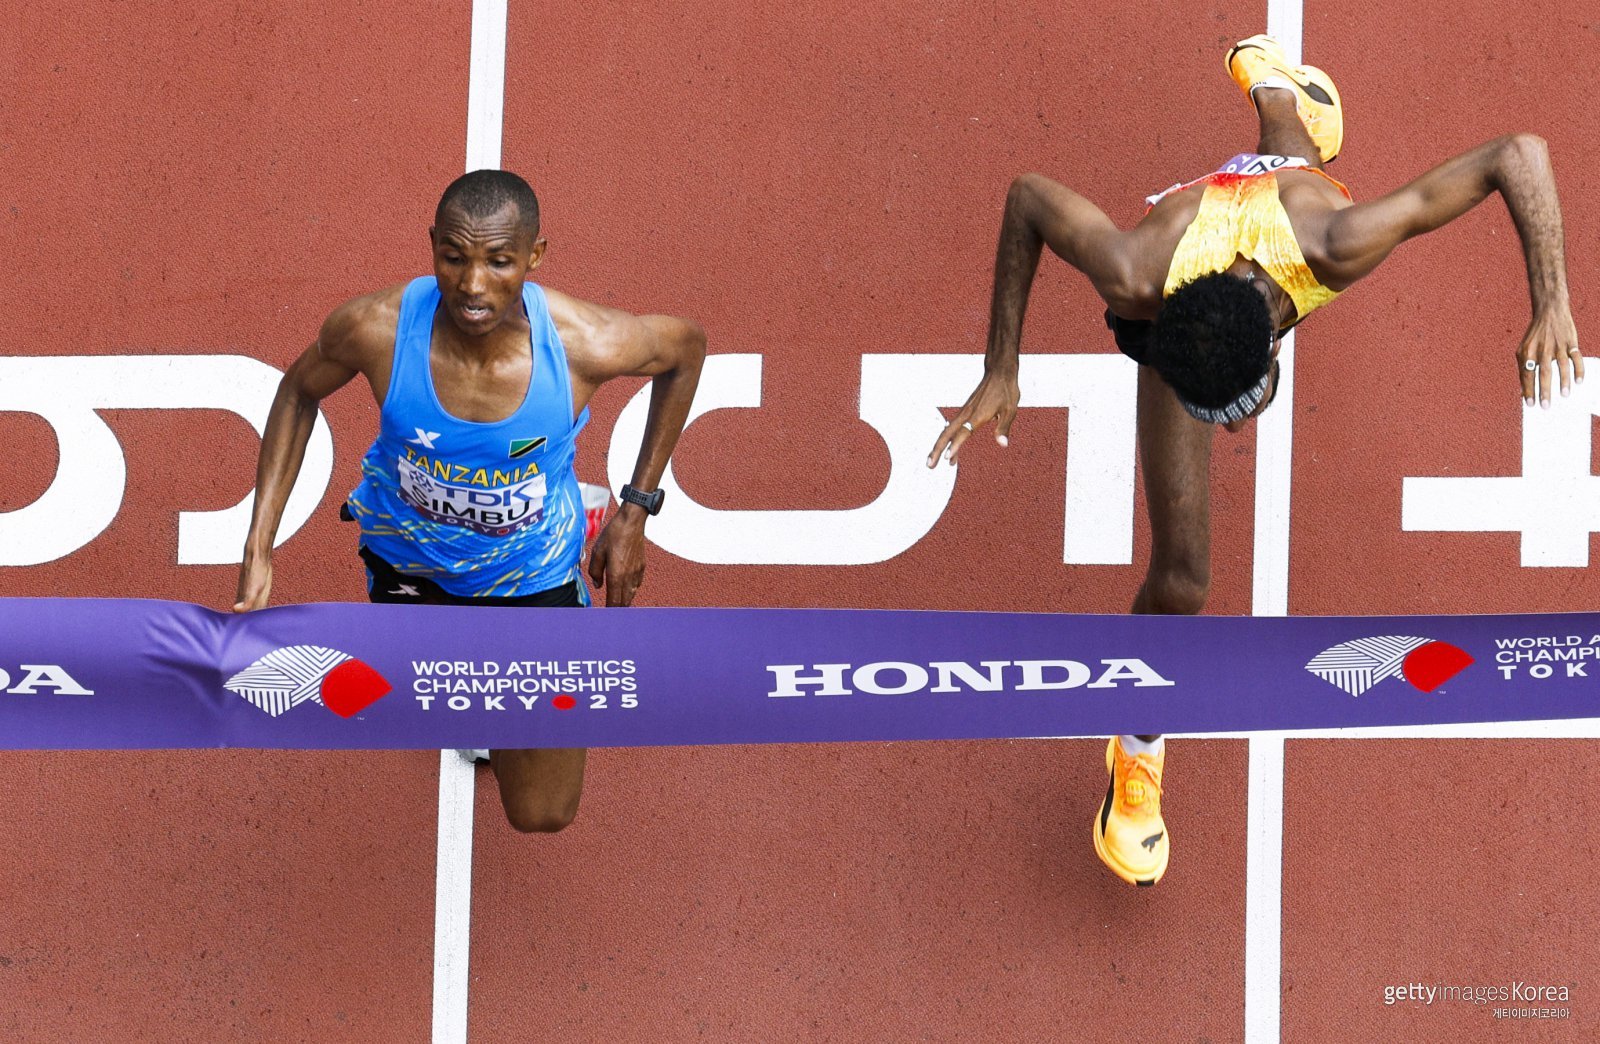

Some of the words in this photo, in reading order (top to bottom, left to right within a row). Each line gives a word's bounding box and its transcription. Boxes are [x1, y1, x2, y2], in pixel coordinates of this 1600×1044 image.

[403, 446, 540, 487] TANZANIA
[411, 484, 530, 525] SIMBU
[433, 481, 535, 507] TDK
[1495, 635, 1582, 649] WORLD
[411, 660, 500, 676] WORLD
[506, 660, 636, 676] ATHLETICS
[766, 658, 1176, 698] HONDA
[413, 677, 637, 693] CHAMPIONSHIPS
